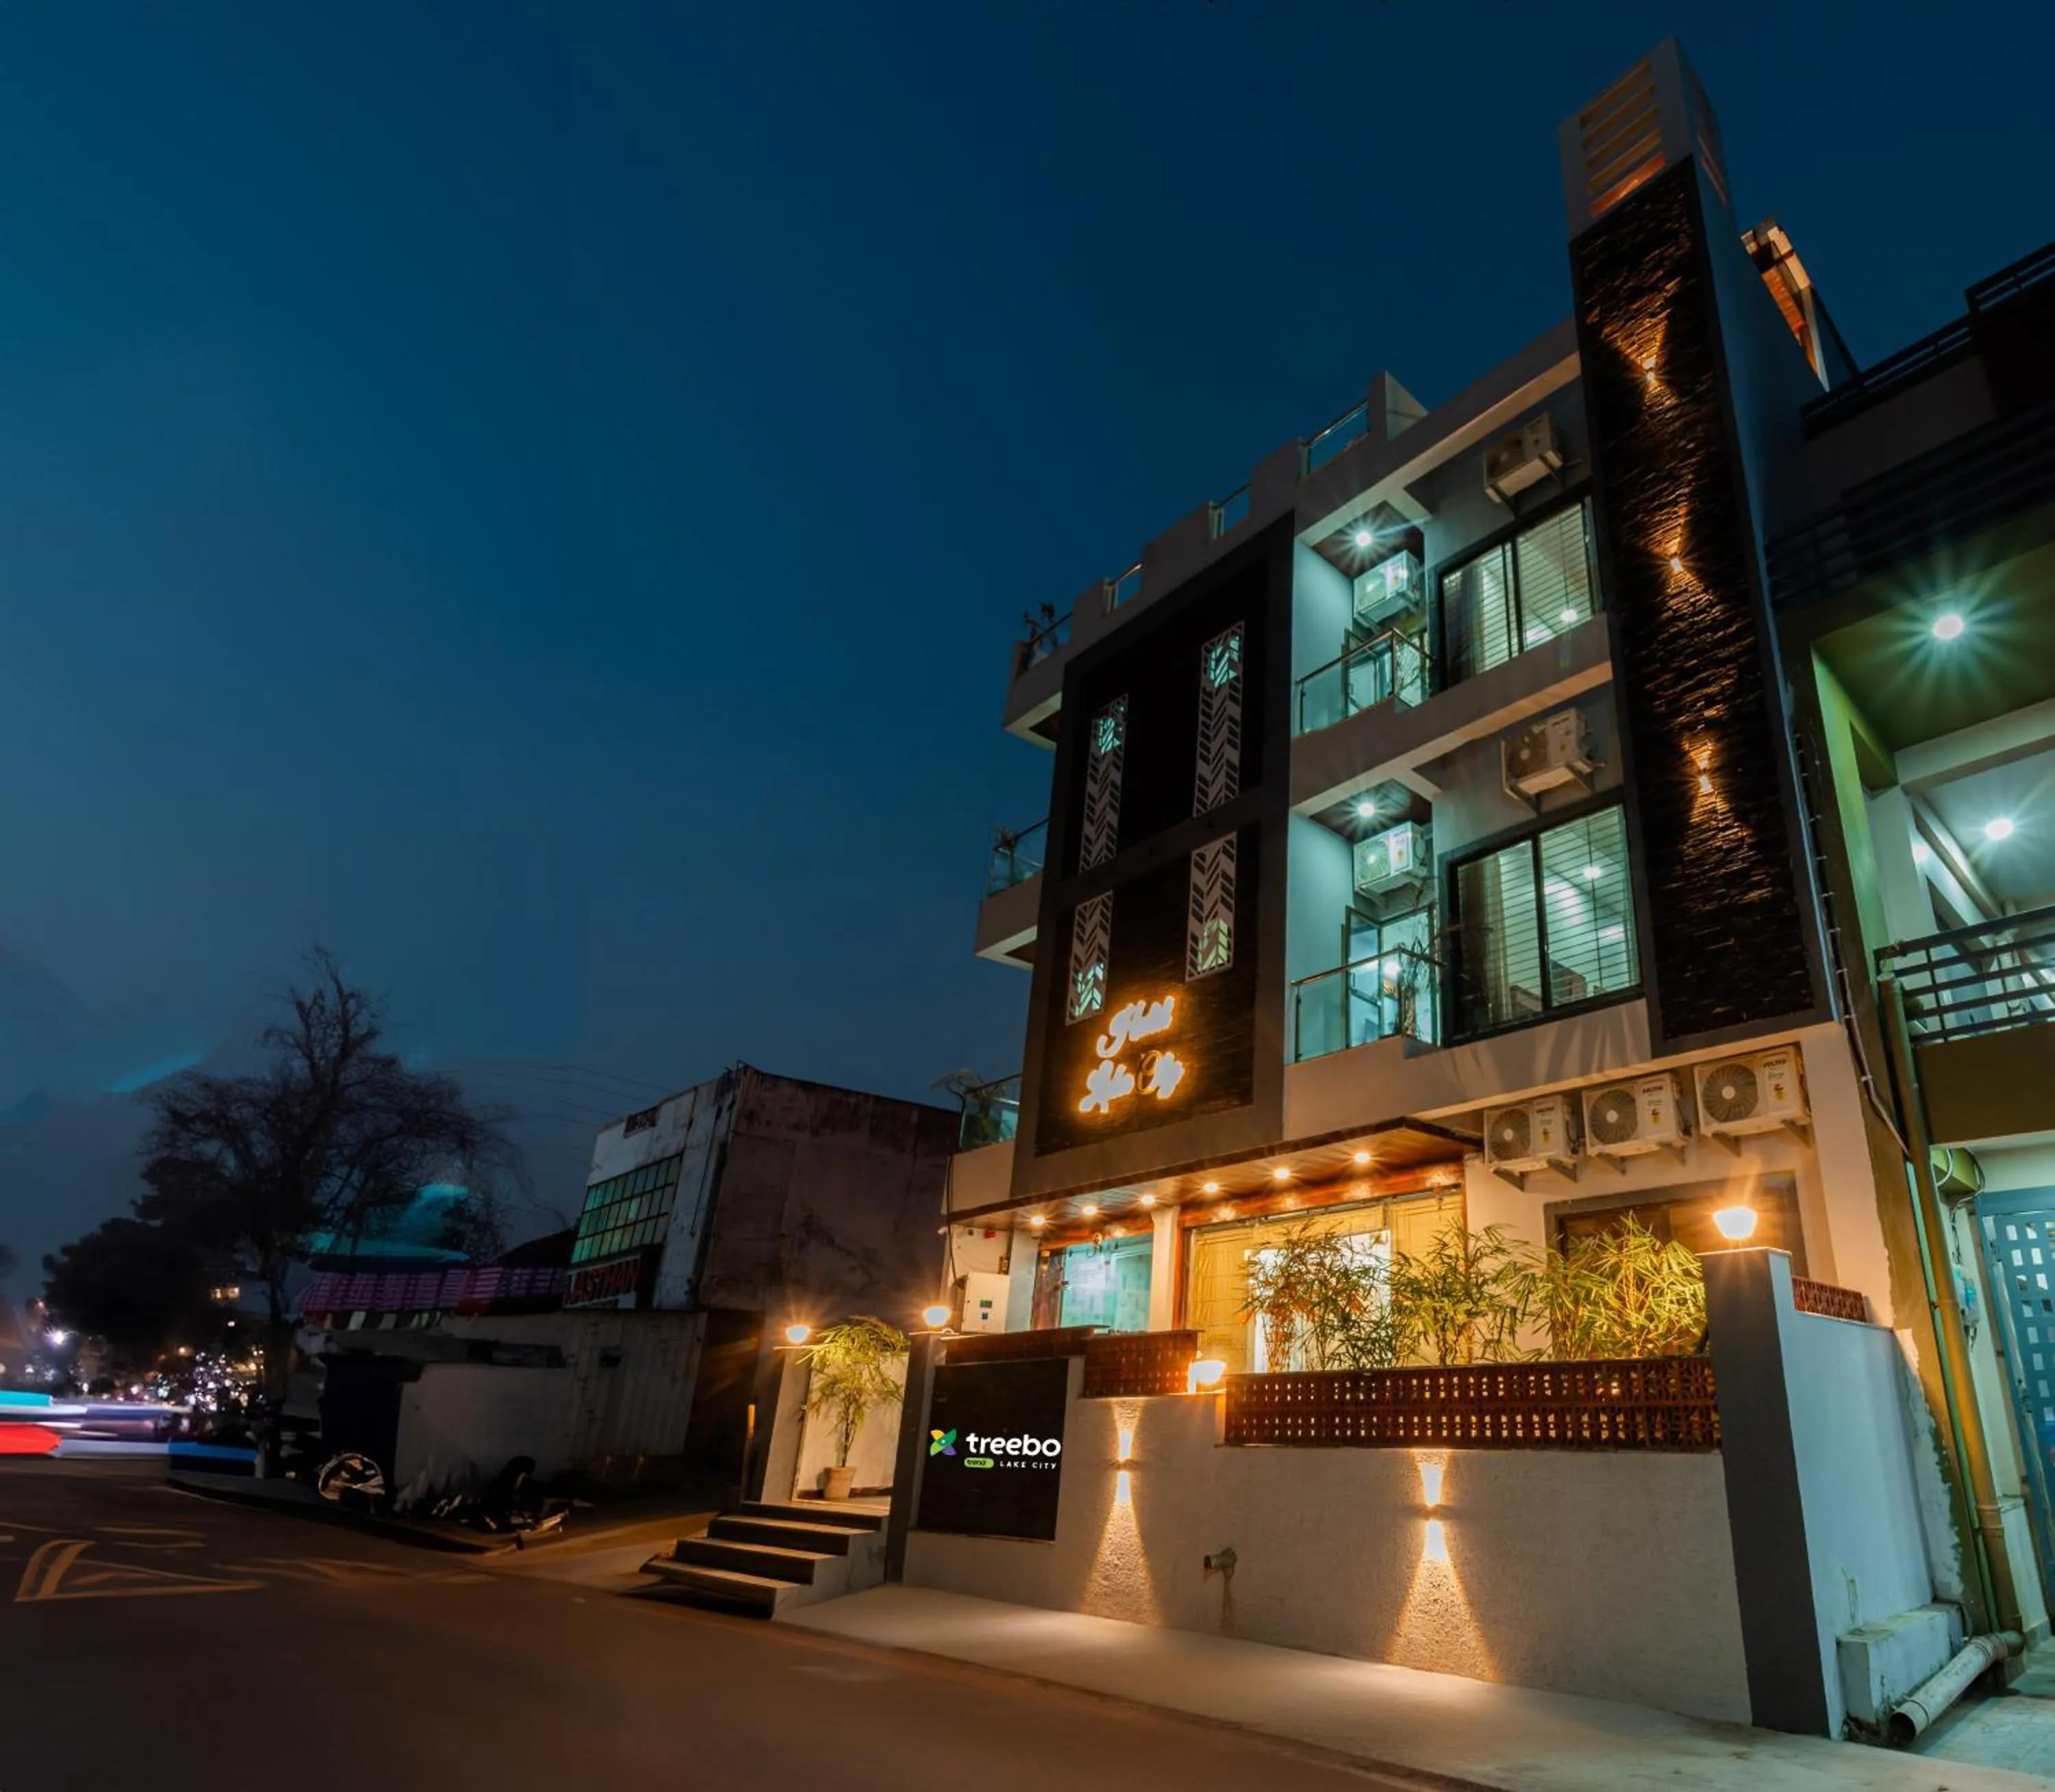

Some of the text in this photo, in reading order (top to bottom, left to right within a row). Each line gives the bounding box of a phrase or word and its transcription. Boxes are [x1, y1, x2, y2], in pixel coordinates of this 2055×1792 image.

[965, 1432, 1061, 1457] treebo
[999, 1460, 1057, 1470] LAKE CITY
